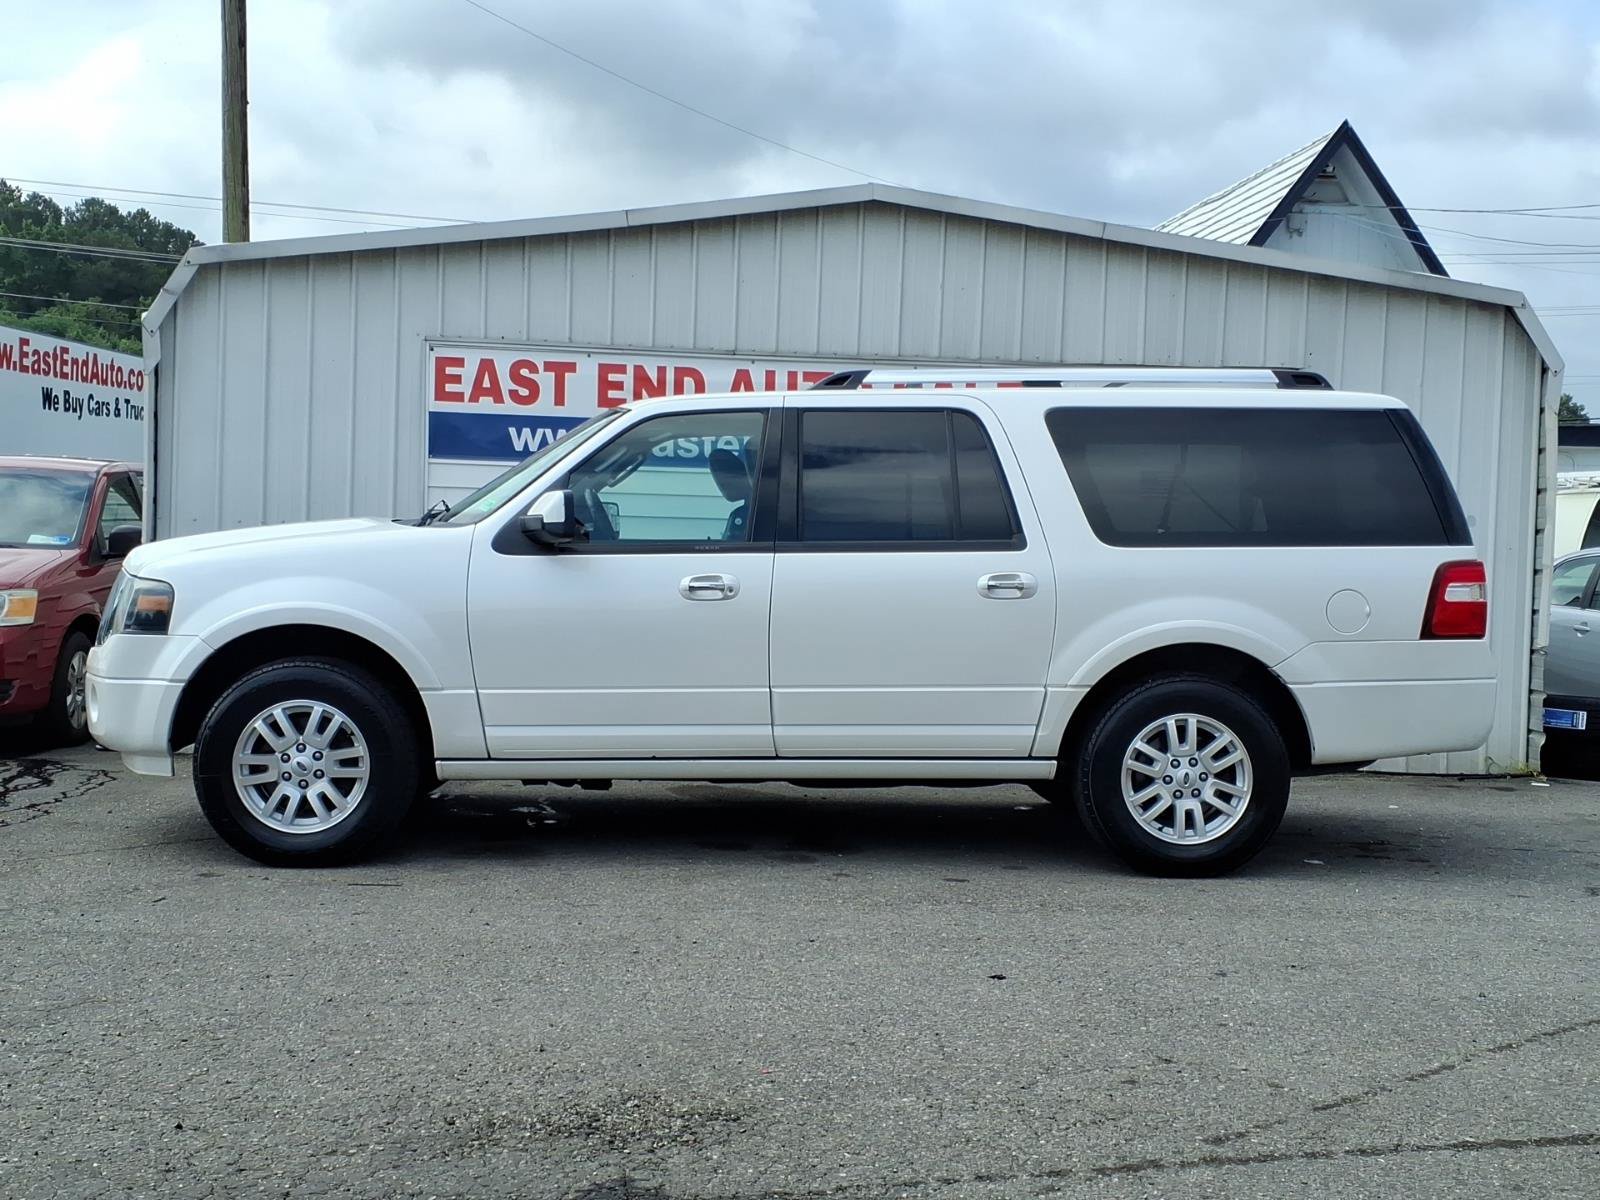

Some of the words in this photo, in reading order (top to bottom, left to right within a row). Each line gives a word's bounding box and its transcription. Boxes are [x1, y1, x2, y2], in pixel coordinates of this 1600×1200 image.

[434, 356, 577, 407] EAST
[597, 362, 706, 408] END
[41, 387, 60, 412] We
[63, 390, 84, 420] Buy
[87, 393, 111, 417] Cars
[113, 397, 121, 418] &
